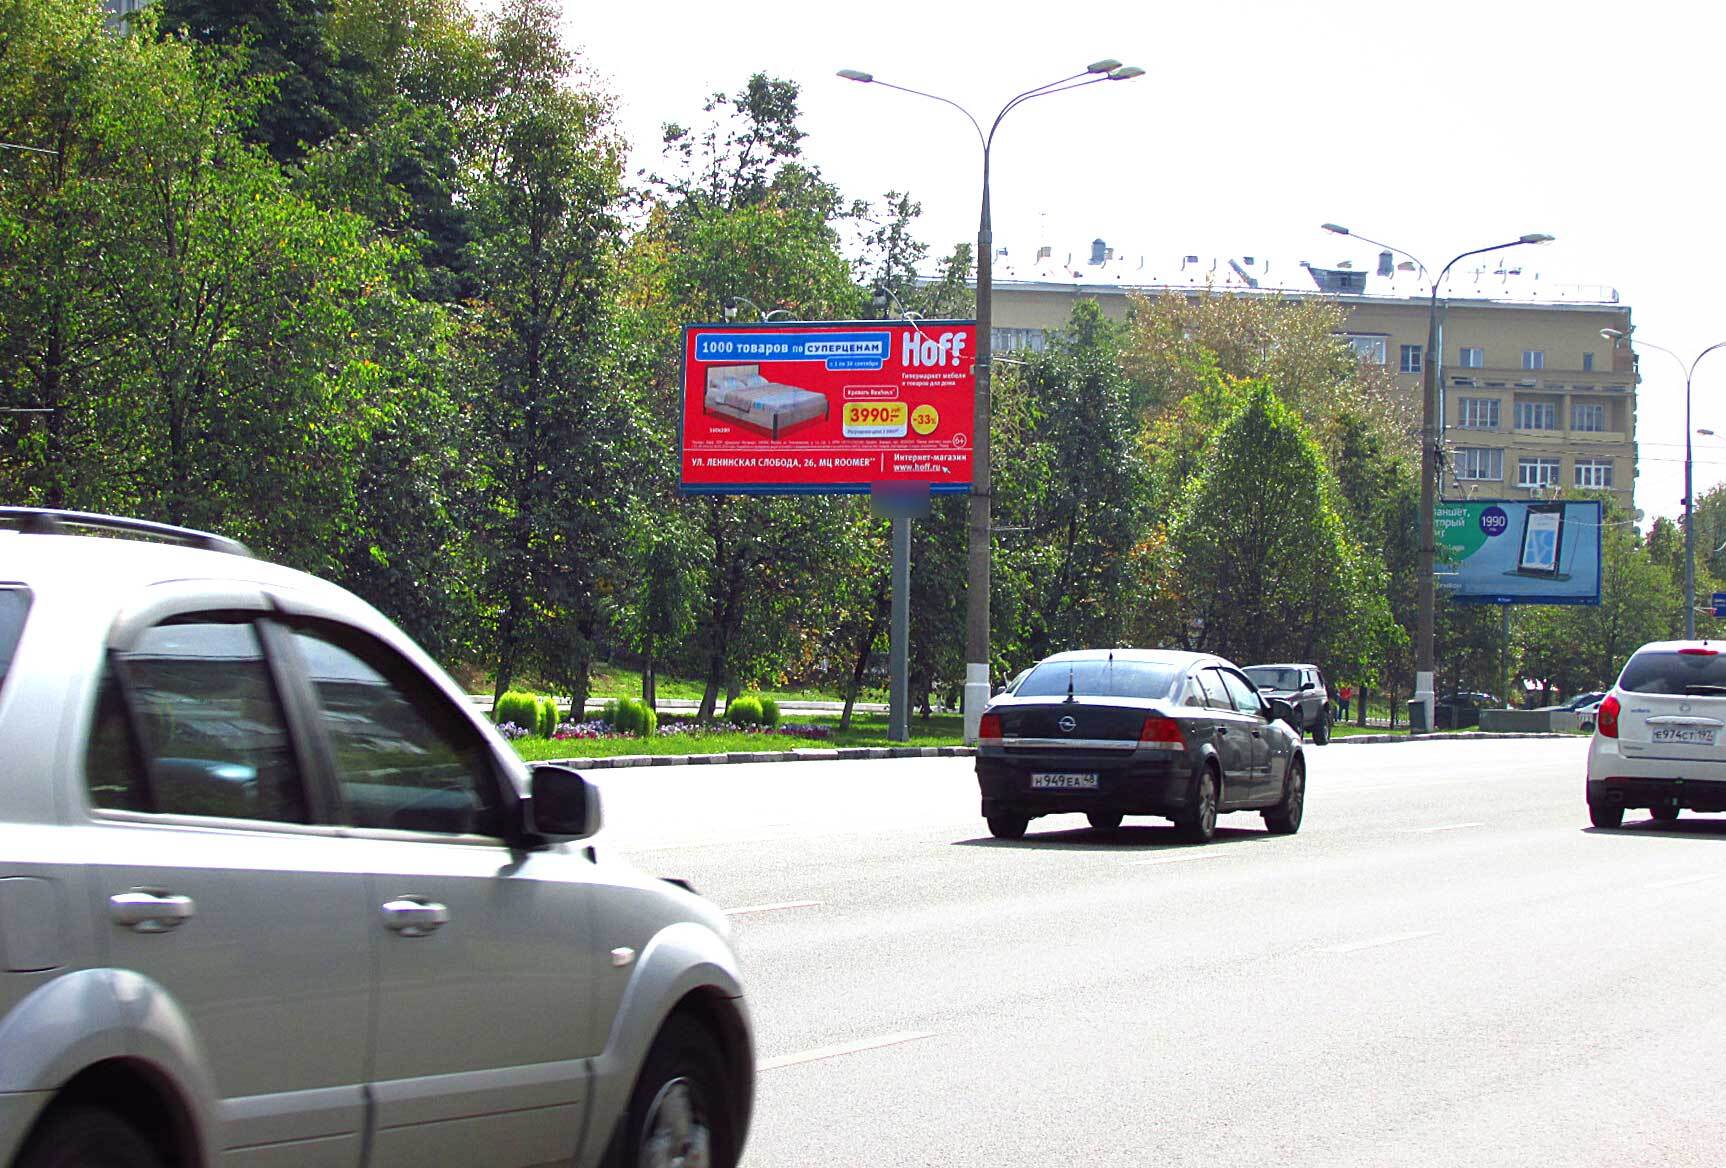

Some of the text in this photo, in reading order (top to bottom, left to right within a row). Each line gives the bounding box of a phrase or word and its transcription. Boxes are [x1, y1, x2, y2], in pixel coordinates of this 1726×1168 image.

[702, 341, 880, 356] 1000 товаров по СУПЕРЦЕНАМ
[692, 458, 704, 467] УЛ.
[707, 458, 756, 467] ЛЕНИНСКАЯ
[758, 458, 802, 468] СЛОБОДА,
[804, 458, 816, 468] 26,
[819, 458, 832, 468] МЦ
[893, 453, 967, 463] Интернет-магазин
[893, 463, 941, 472] www.hoff.ru
[1434, 508, 1470, 518] аншет,
[1482, 516, 1506, 527] 1990
